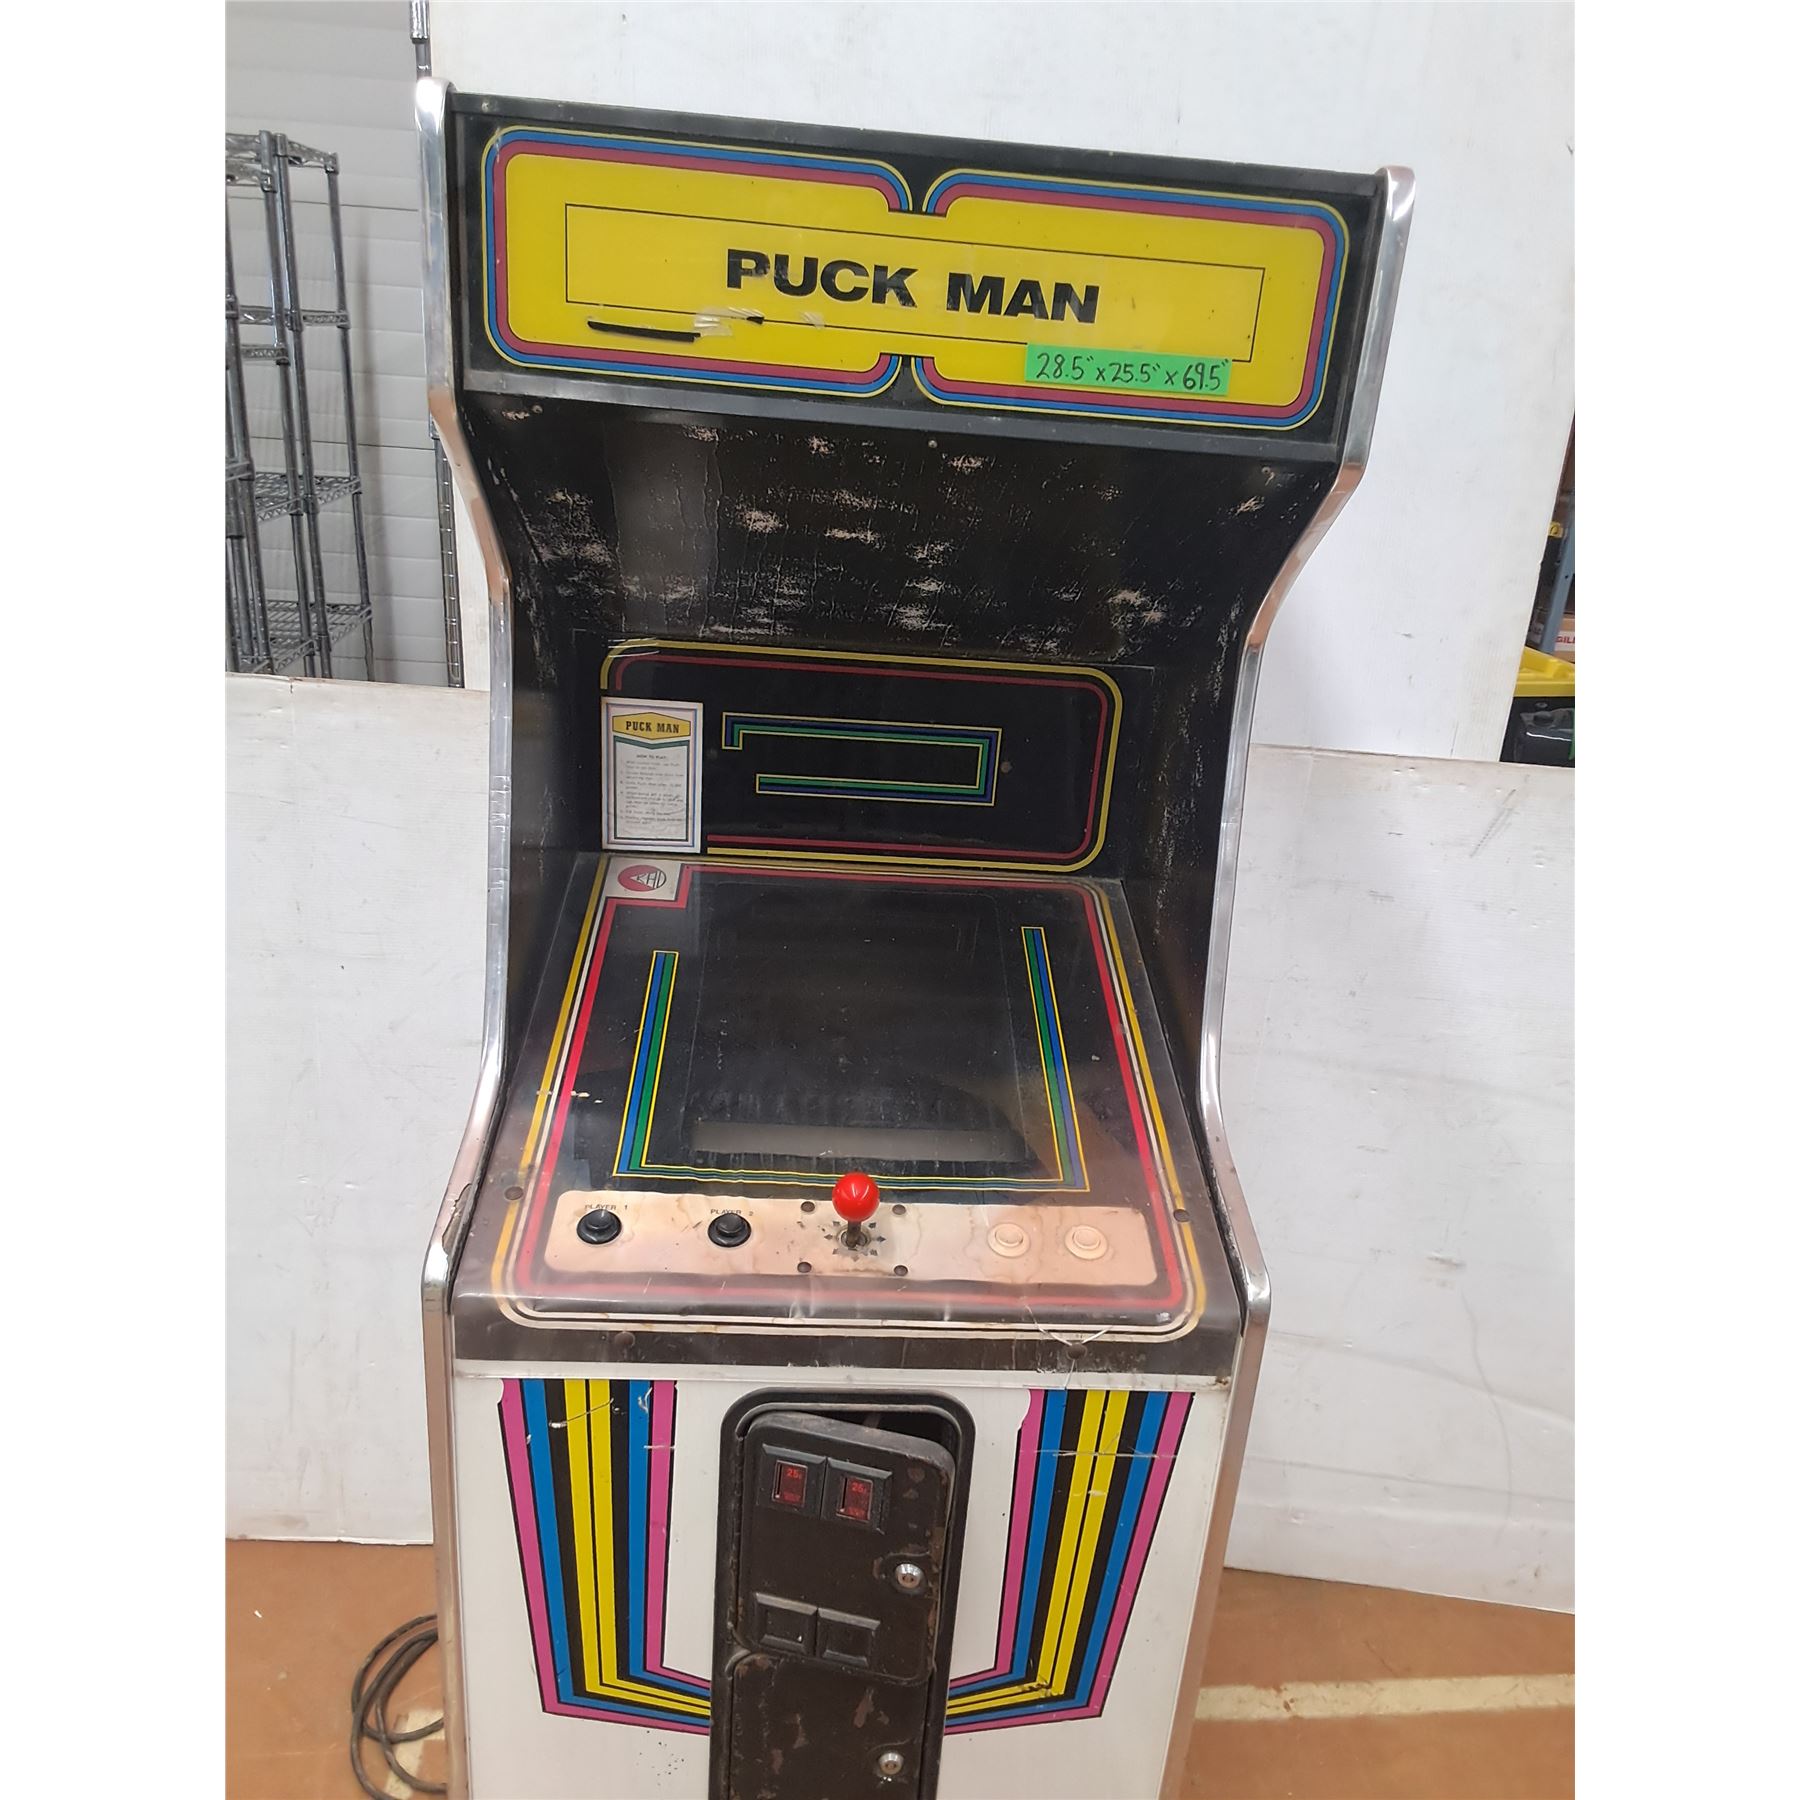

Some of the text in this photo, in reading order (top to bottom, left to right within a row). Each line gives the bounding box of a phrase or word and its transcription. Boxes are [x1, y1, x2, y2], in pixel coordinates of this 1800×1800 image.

[727, 249, 1100, 323] PUCK MAN
[625, 721, 680, 733] PUCK MAN
